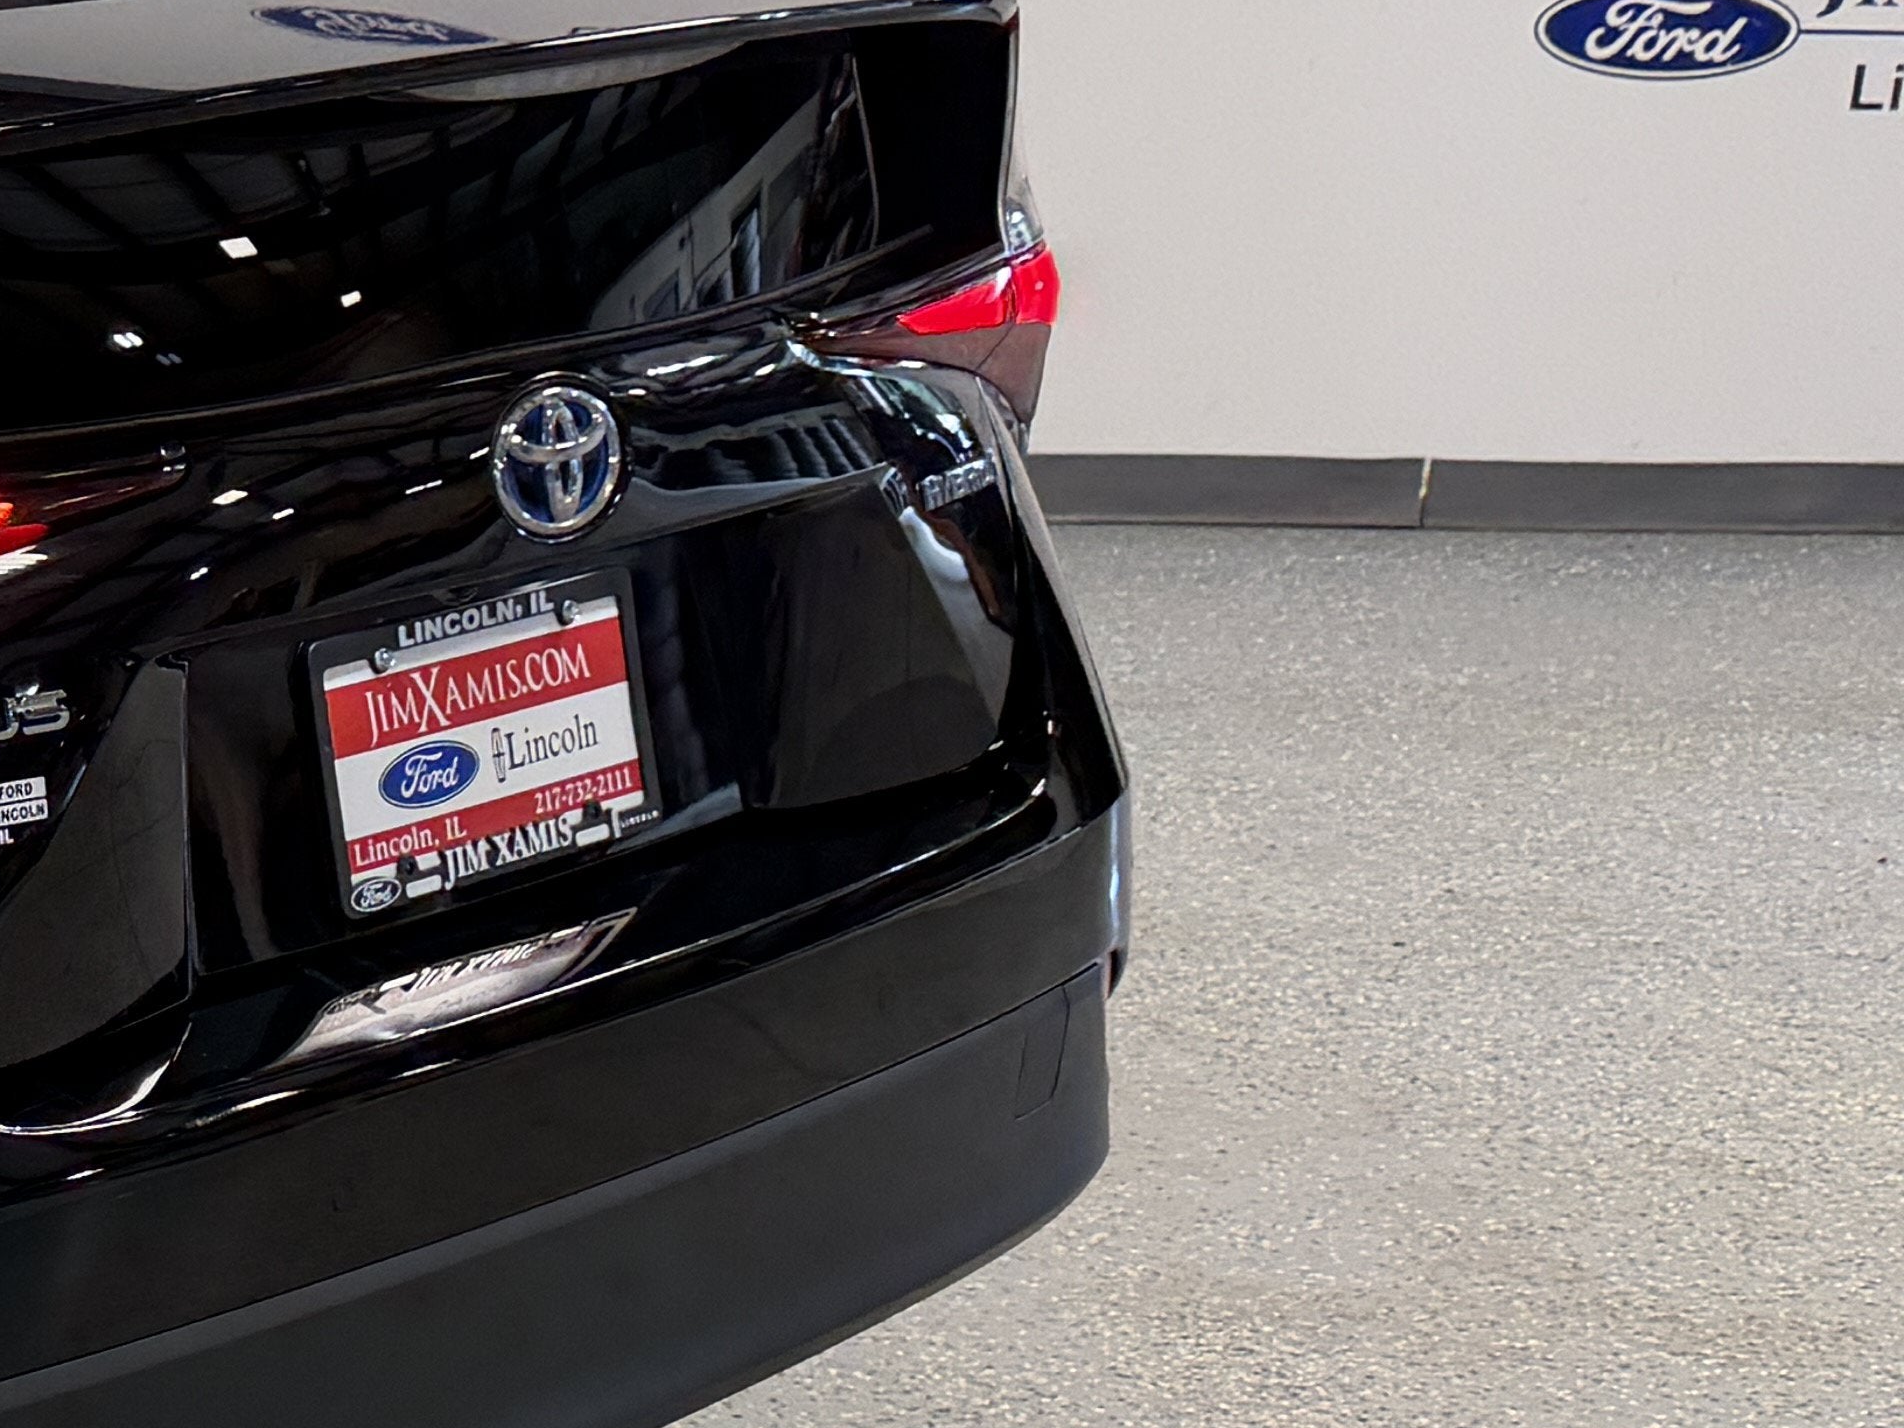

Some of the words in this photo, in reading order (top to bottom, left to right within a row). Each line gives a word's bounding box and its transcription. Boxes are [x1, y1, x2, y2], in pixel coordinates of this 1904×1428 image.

[397, 598, 523, 648] LINCOLN,
[530, 590, 554, 614] IL
[505, 714, 599, 771] Lincoln
[401, 751, 460, 798] Ford
[353, 825, 440, 867] Lincoln,
[445, 816, 467, 841] IL
[444, 840, 492, 891] JIM
[495, 817, 574, 867] XAMIS
